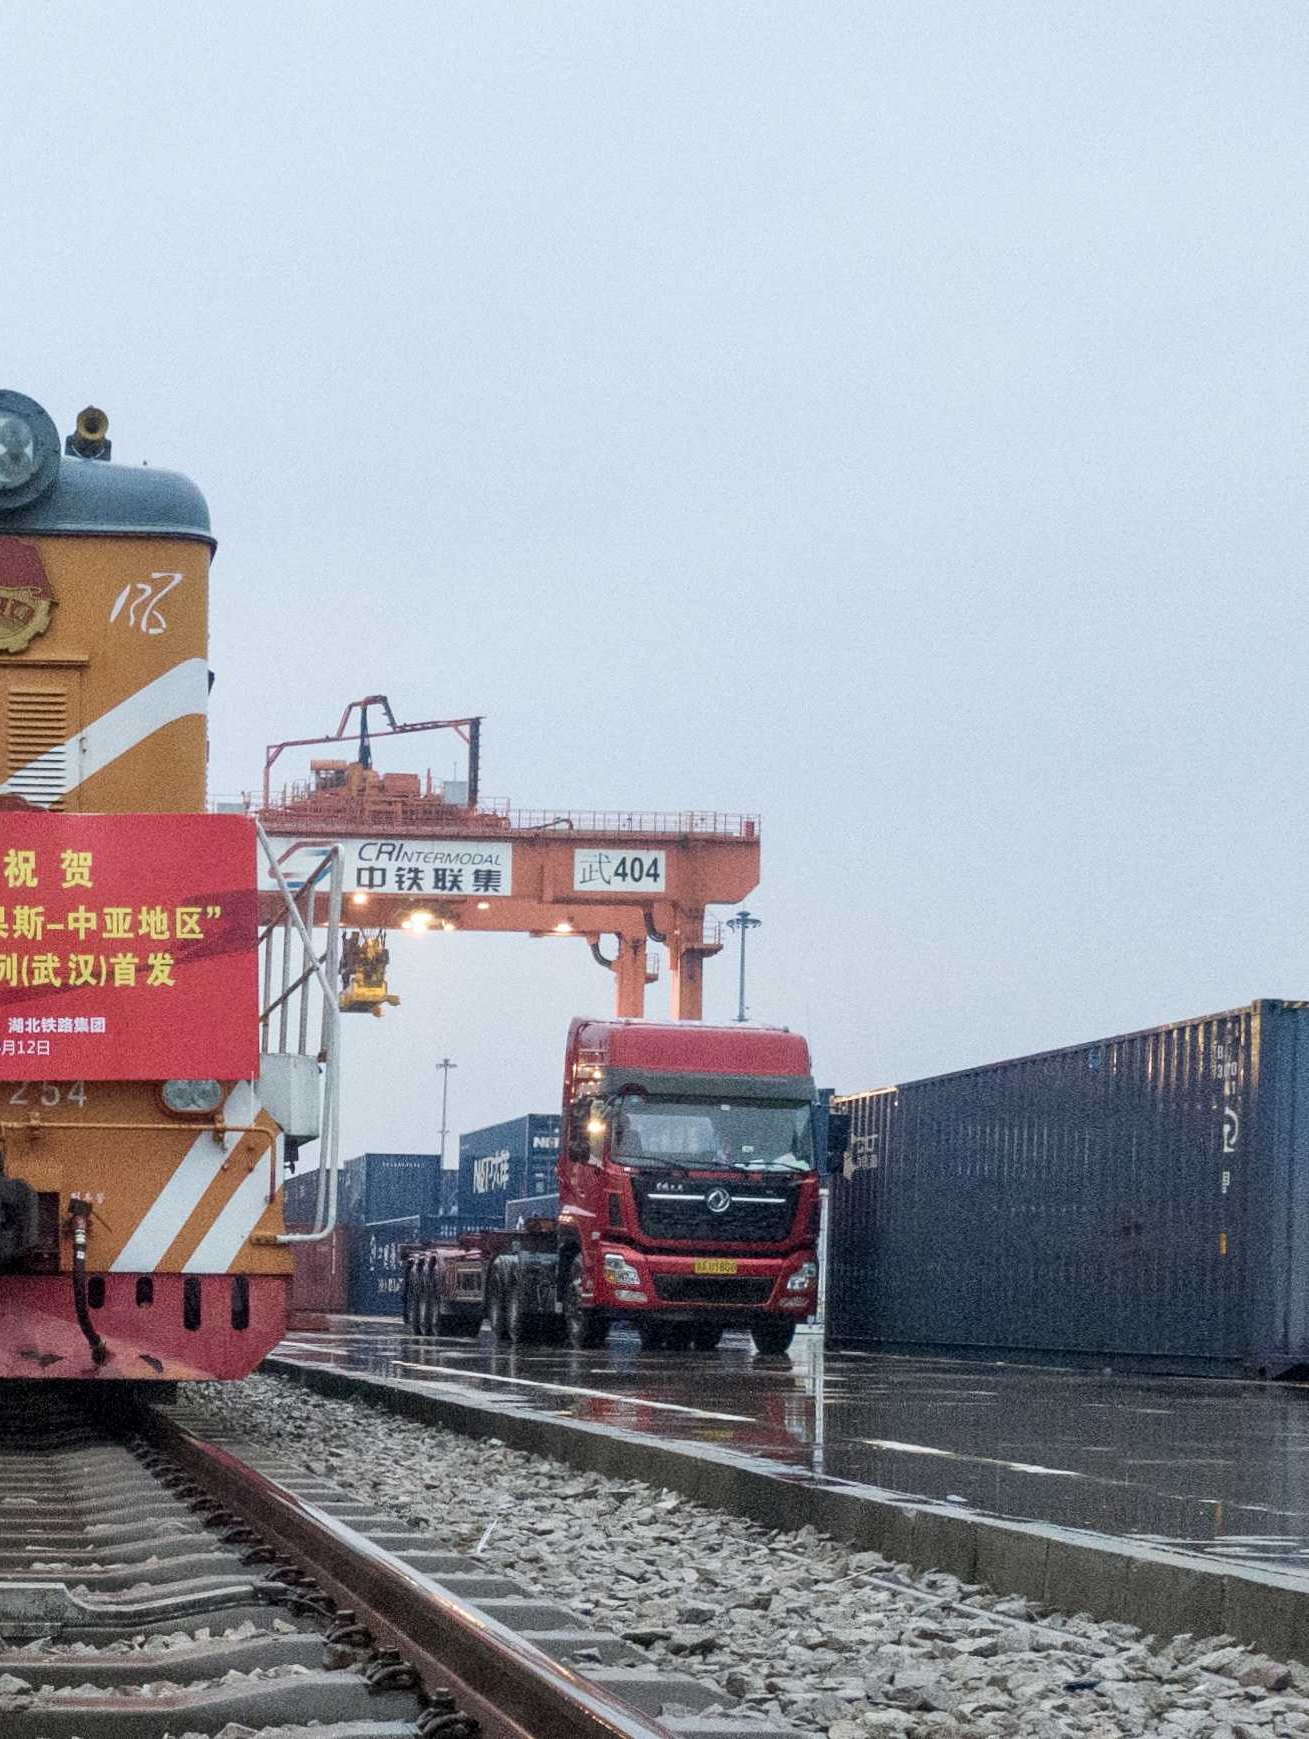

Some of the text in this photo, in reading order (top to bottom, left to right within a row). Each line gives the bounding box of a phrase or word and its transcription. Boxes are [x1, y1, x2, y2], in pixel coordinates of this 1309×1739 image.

[356, 866, 502, 893] 中铁联集
[579, 852, 660, 885] 武404
[8, 1017, 106, 1034] 湖北铁路集团
